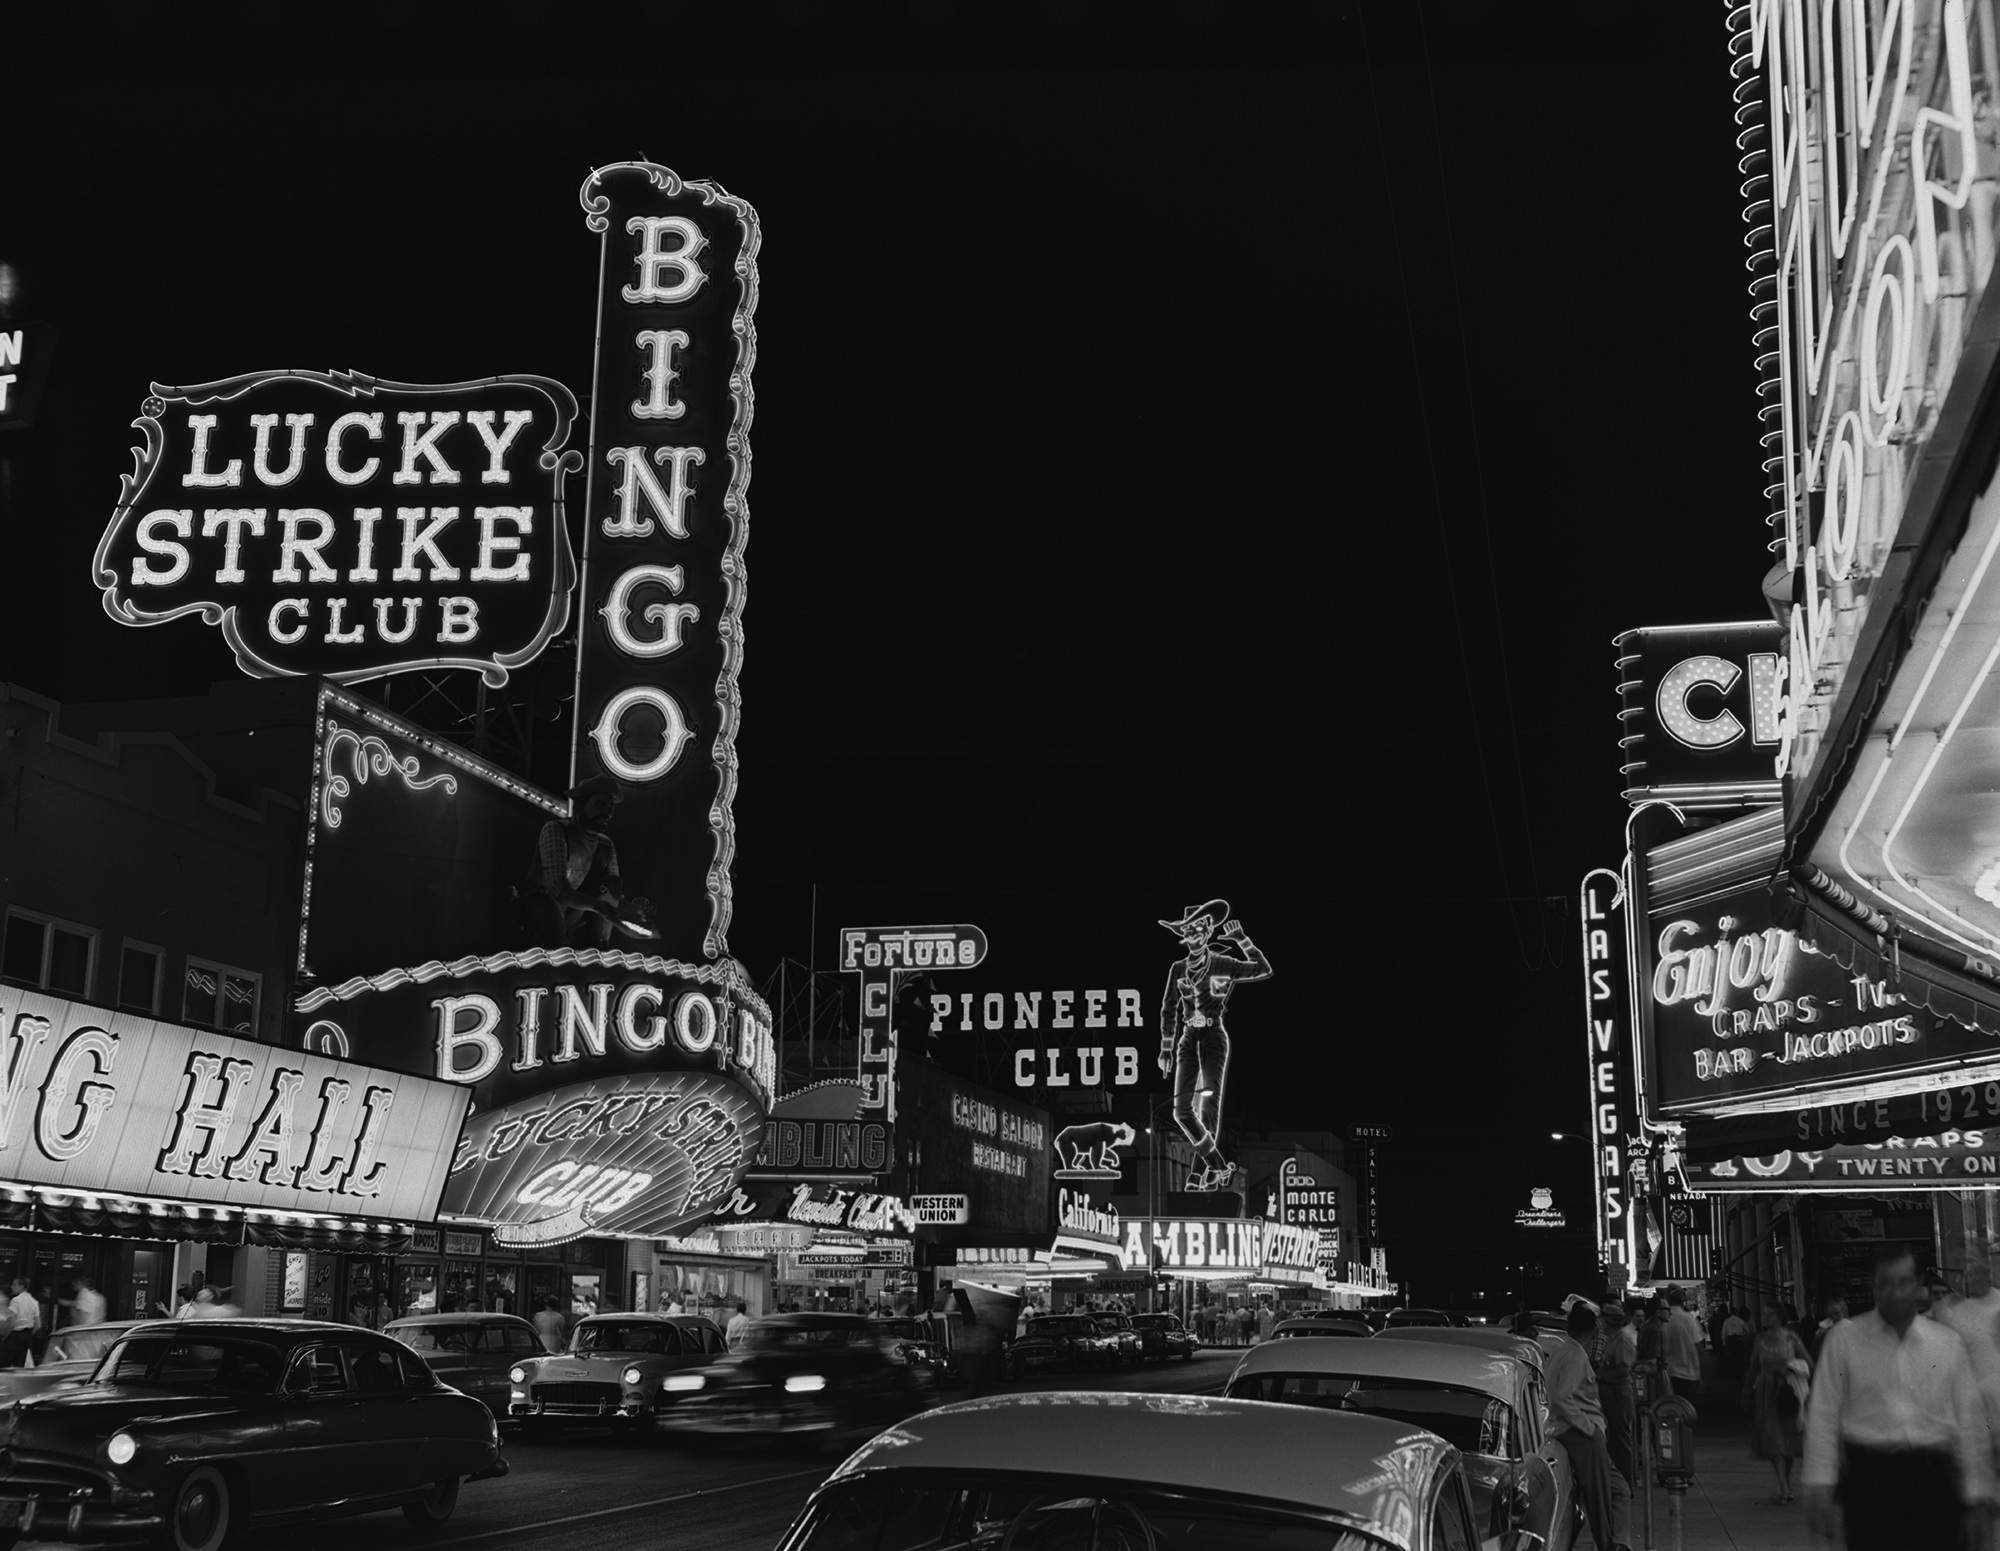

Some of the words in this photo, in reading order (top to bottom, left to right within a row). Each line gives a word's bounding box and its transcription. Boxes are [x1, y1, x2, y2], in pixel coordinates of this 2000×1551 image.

[182, 410, 533, 487] LUCKY
[588, 216, 711, 782] BINGO
[131, 506, 533, 585] STRIKE
[267, 597, 480, 644] CLUB
[846, 931, 976, 967] Fortune
[1589, 889, 1610, 1000] LAS
[1653, 915, 1799, 1016] Enjoy
[931, 989, 1143, 1031] PIONEER
[1713, 995, 1822, 1038] CRAPS
[431, 982, 718, 1083] BINGO
[1694, 1048, 1753, 1081] BAR
[1777, 1016, 1919, 1064] JACKPOTS
[1015, 1047, 1139, 1087] CLUB
[156, 1050, 394, 1199] HALL
[954, 1094, 997, 1137] CASINO
[1356, 1128, 1388, 1137] HOTEL
[1593, 1019, 1623, 1218] VEGAS
[1797, 1099, 1891, 1140] SINCE
[1921, 1082, 2000, 1122] 1929
[973, 1142, 1027, 1178] RESTAURANT
[1837, 1157, 1949, 1176] TWENTY
[517, 1160, 652, 1213] CLUB
[788, 1183, 846, 1225] Nevada
[912, 1197, 964, 1209] WESTERN
[1287, 1191, 1336, 1205] MONTE
[919, 1209, 957, 1222] UNION
[1059, 1188, 1120, 1238] California
[1287, 1209, 1336, 1222] CARLO
[735, 1231, 804, 1248] CAFE
[1124, 1222, 1261, 1266] AMBLING
[815, 1270, 858, 1279] BREAKFAST
[1097, 1279, 1146, 1292] JACKPOTS
